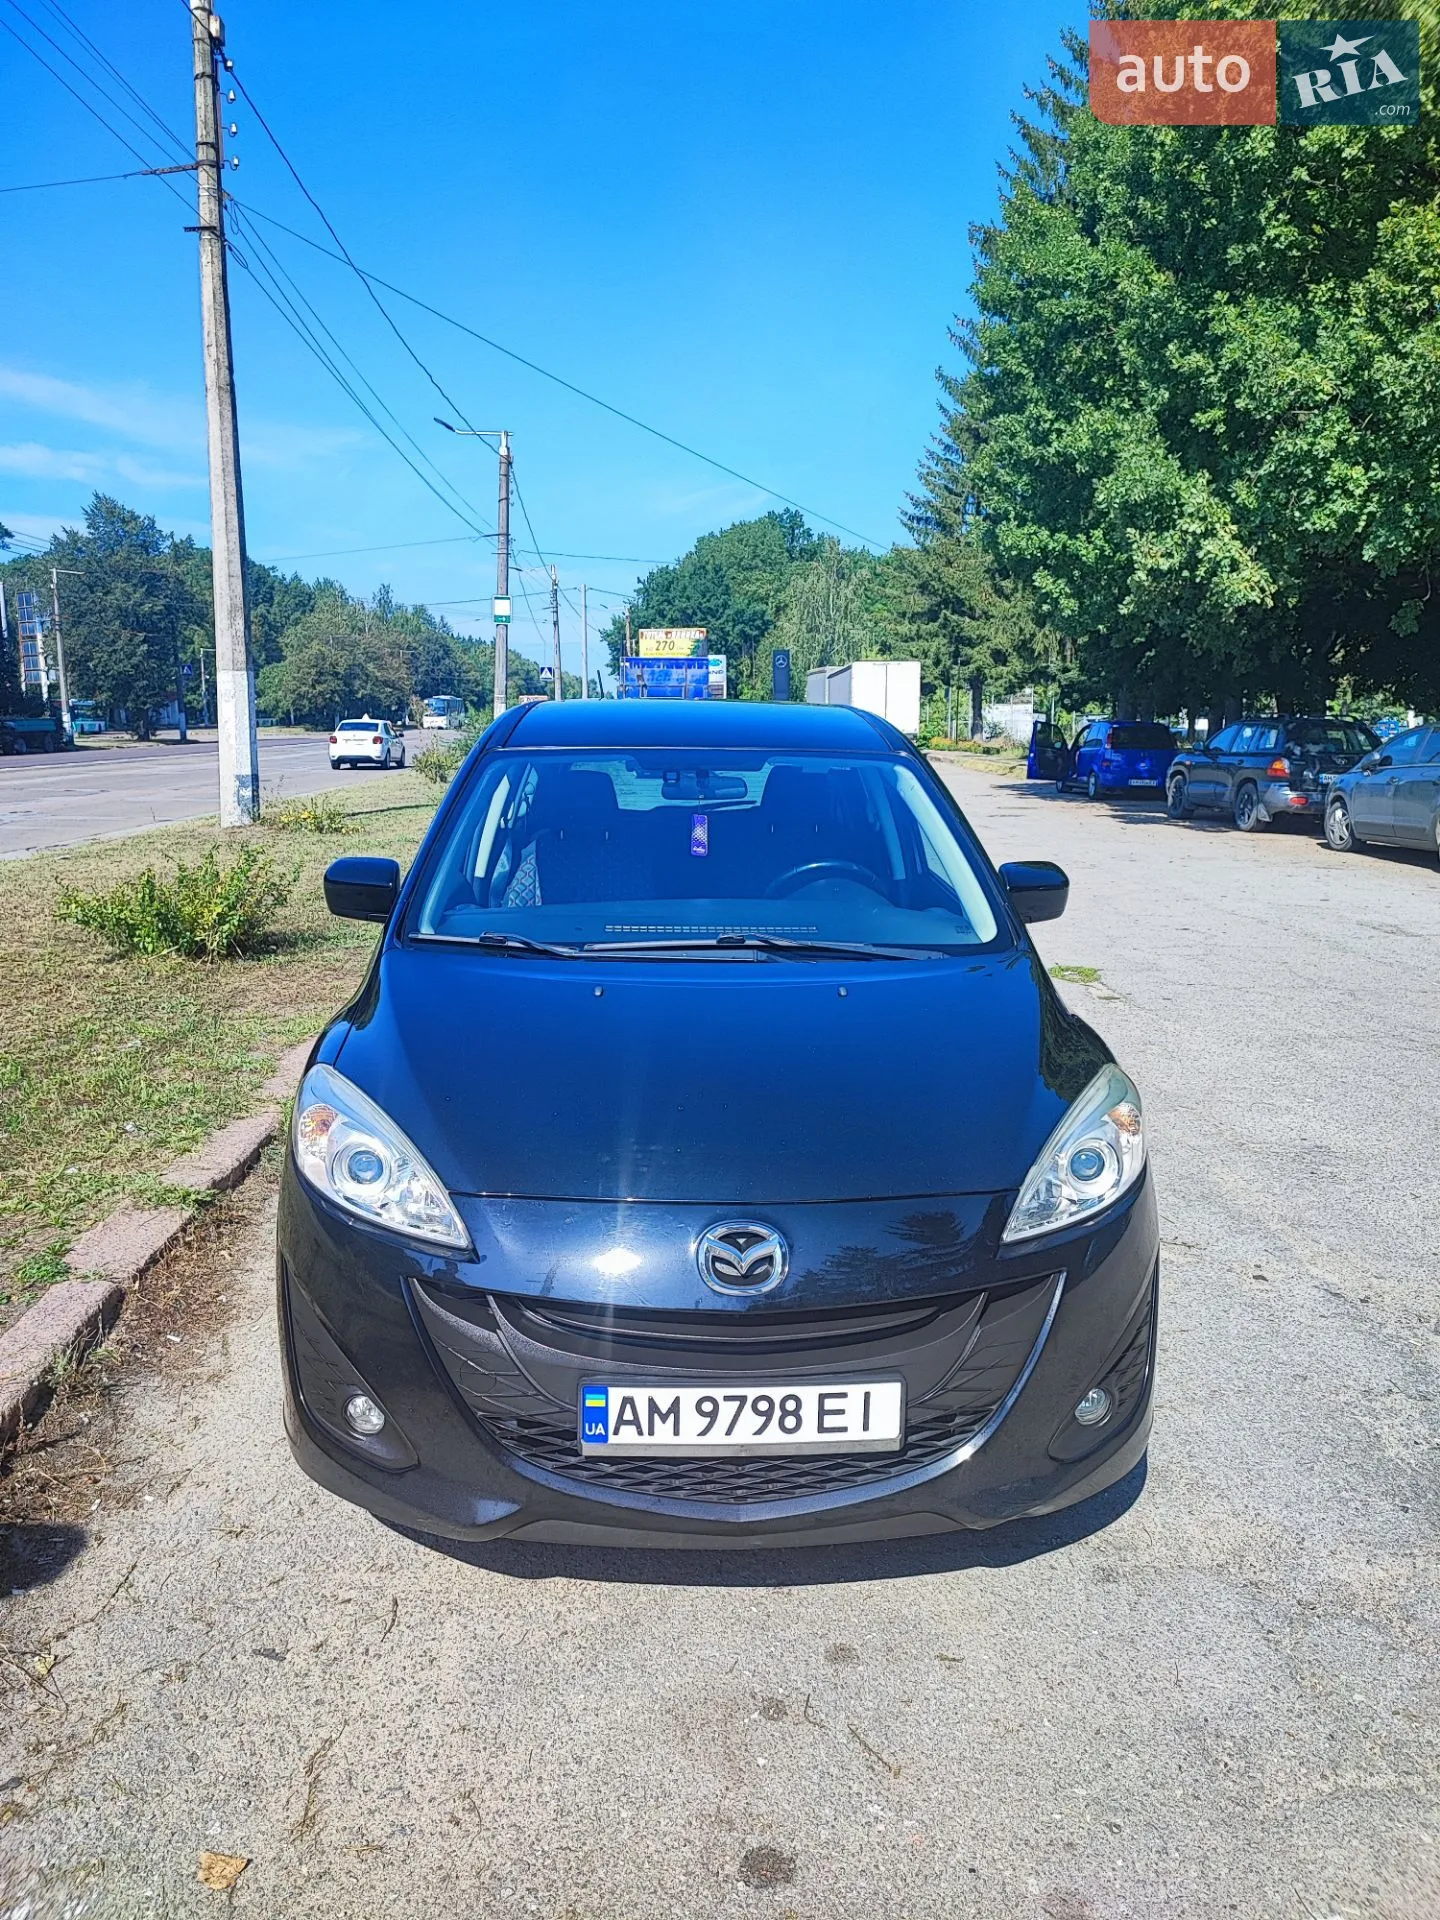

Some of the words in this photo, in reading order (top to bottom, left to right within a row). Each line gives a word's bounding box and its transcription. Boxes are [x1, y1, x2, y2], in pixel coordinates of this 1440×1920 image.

[655, 640, 675, 651] 270
[612, 1395, 681, 1437] AM
[695, 1393, 803, 1437] 9798
[817, 1391, 871, 1434] EI
[585, 1423, 606, 1436] UA
